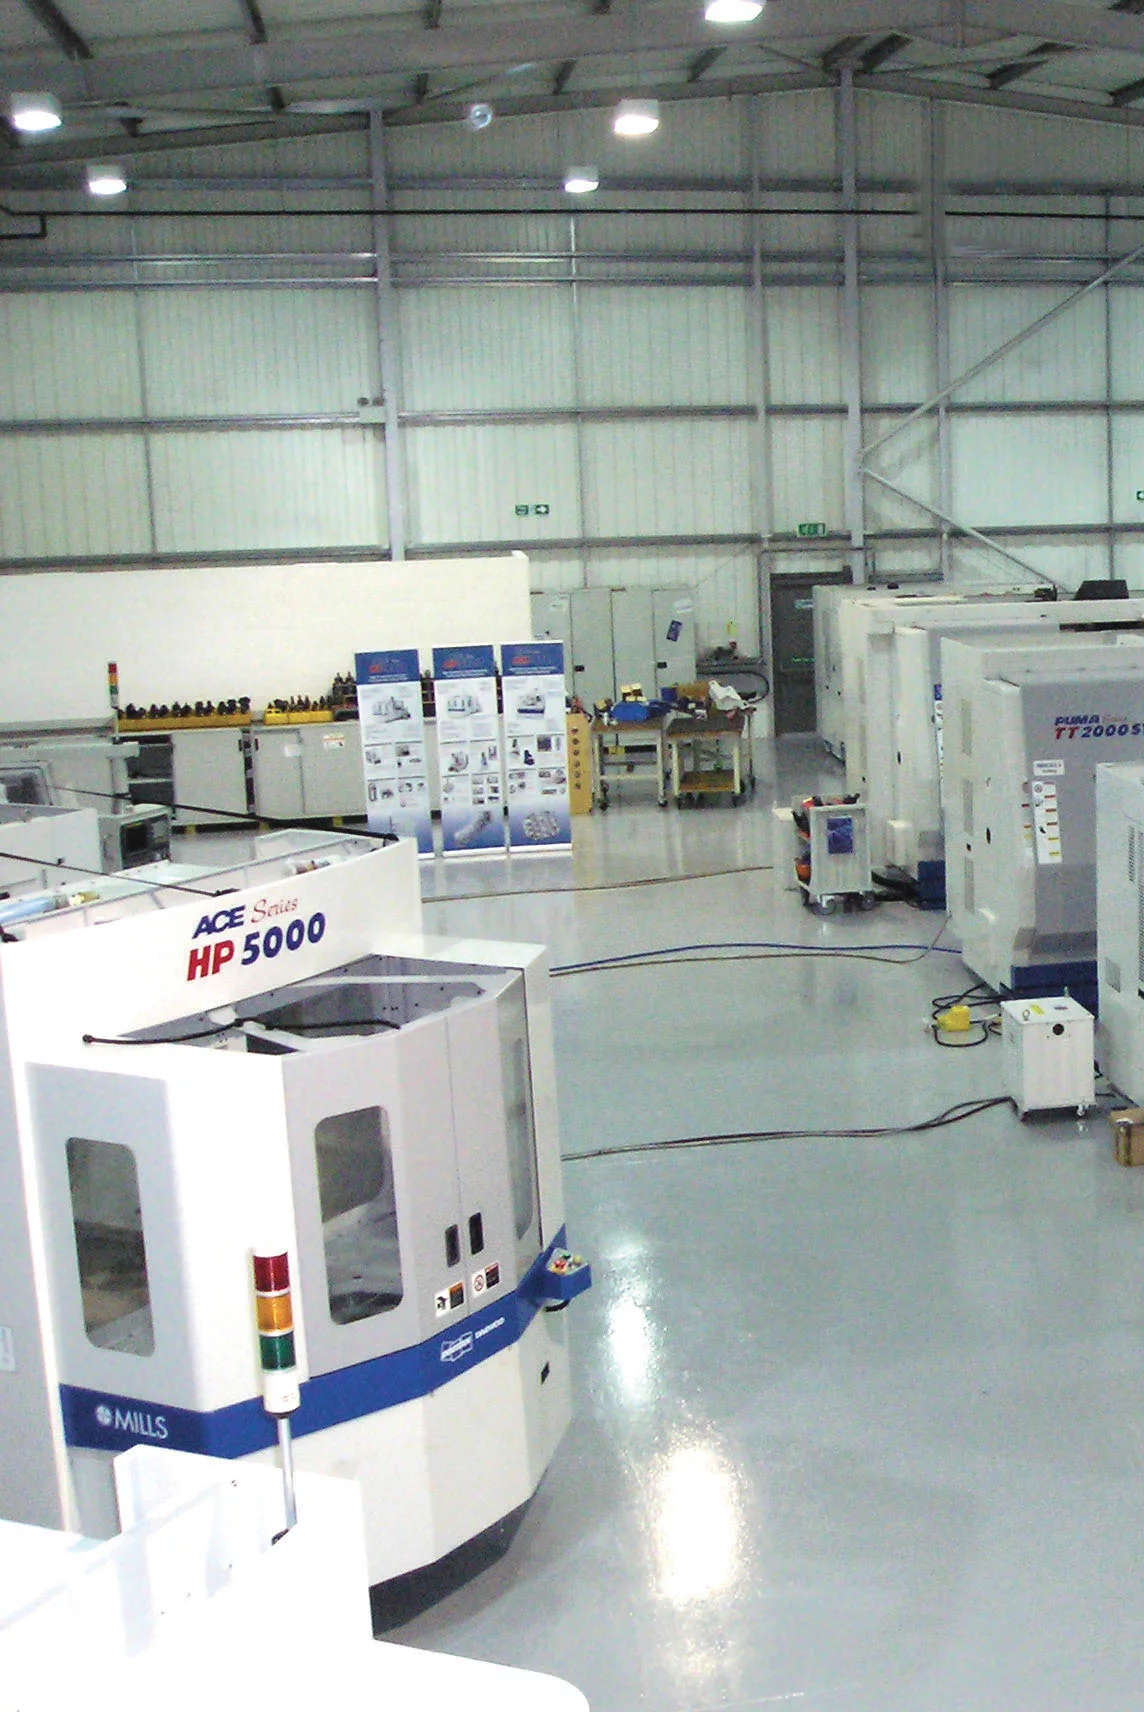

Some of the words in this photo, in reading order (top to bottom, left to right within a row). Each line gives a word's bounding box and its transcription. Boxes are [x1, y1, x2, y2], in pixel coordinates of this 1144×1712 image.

[1054, 715, 1100, 726] PUMA
[1055, 726, 1079, 740] TT
[192, 904, 247, 940] ACE
[250, 898, 299, 923] Series
[186, 940, 235, 982] HP
[240, 911, 327, 966] 5000
[114, 1407, 169, 1440] MILLS
